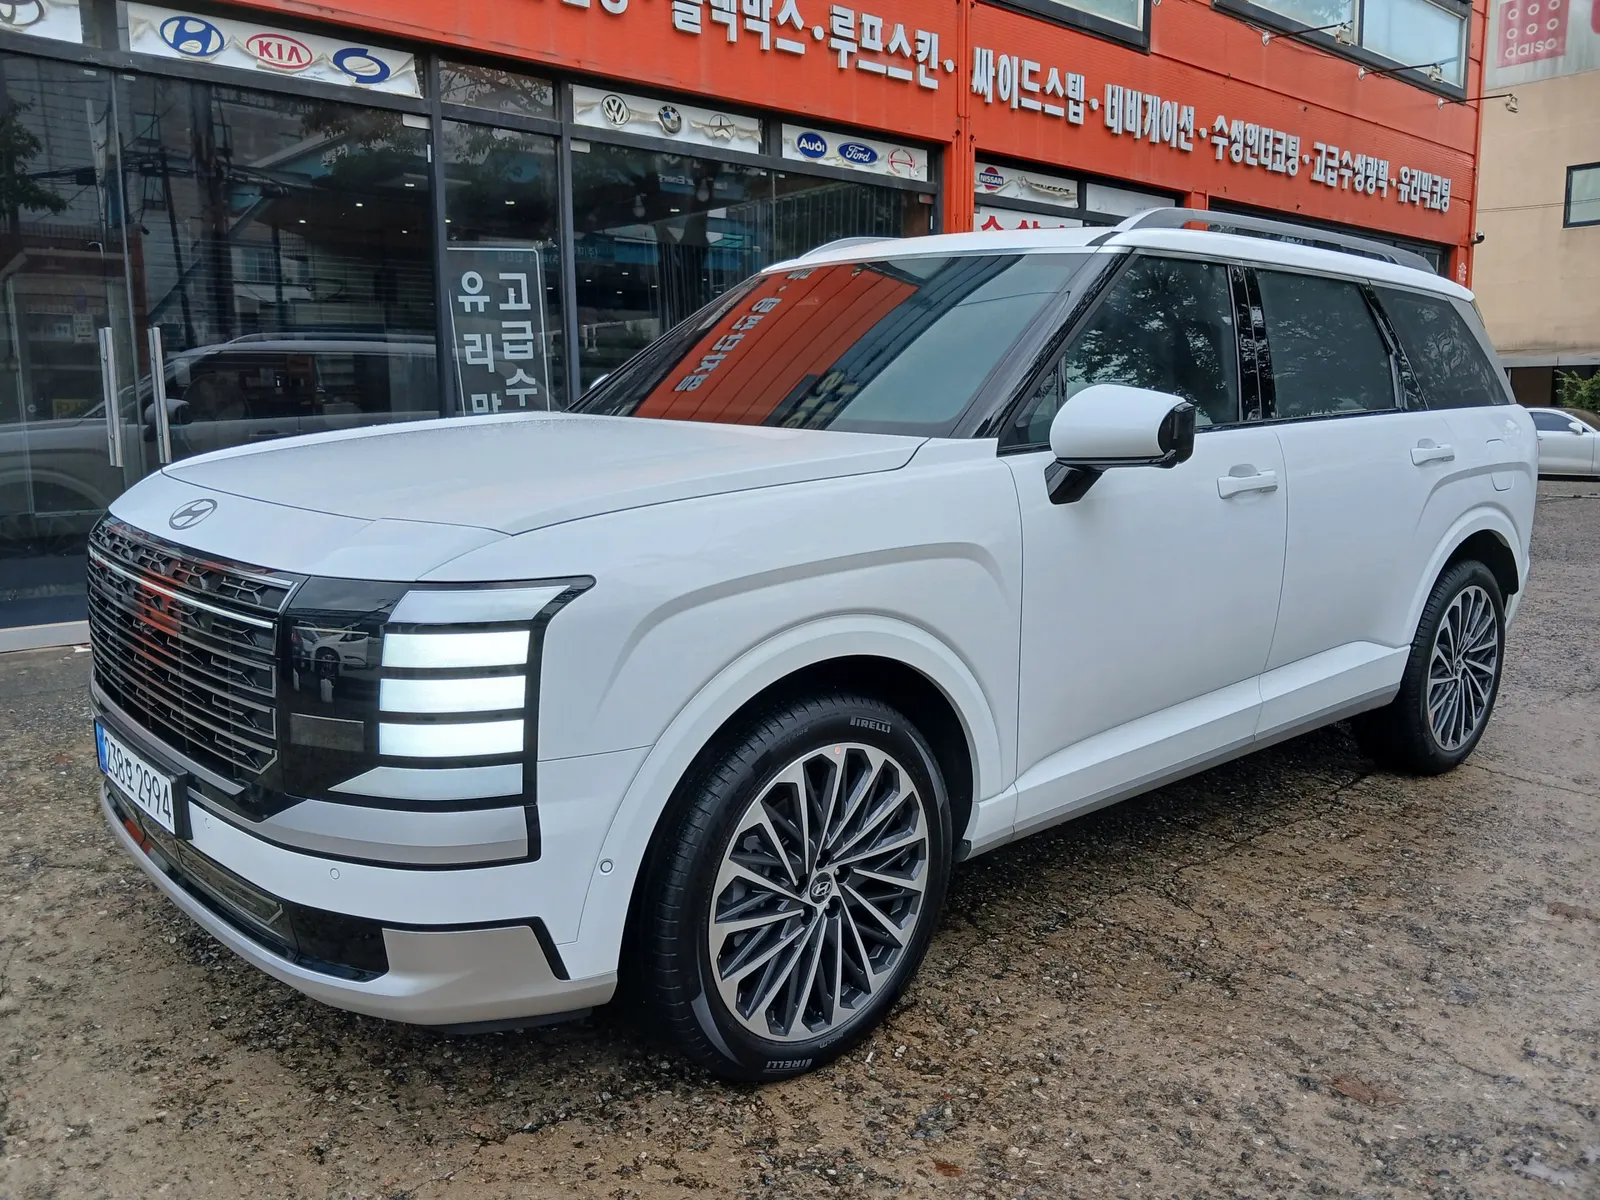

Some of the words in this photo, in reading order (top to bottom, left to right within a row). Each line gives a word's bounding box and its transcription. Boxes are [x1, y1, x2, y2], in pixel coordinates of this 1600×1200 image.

[257, 40, 303, 63] KIA
[1505, 38, 1557, 59] daiso
[829, 5, 939, 90] 루프스킨
[1104, 84, 1195, 152] 네비게이션
[1211, 115, 1301, 177] 수성언더코팅
[1310, 141, 1389, 198] 고급수성광택
[1397, 166, 1452, 213] 유리막코팅
[799, 137, 825, 152] Audi
[845, 144, 871, 163] Ford
[980, 174, 1003, 186] NISSAN
[849, 715, 891, 734] PIRELLI
[104, 736, 135, 793] 238호
[136, 762, 172, 825] 2994
[763, 1058, 813, 1074] PIRELLI
